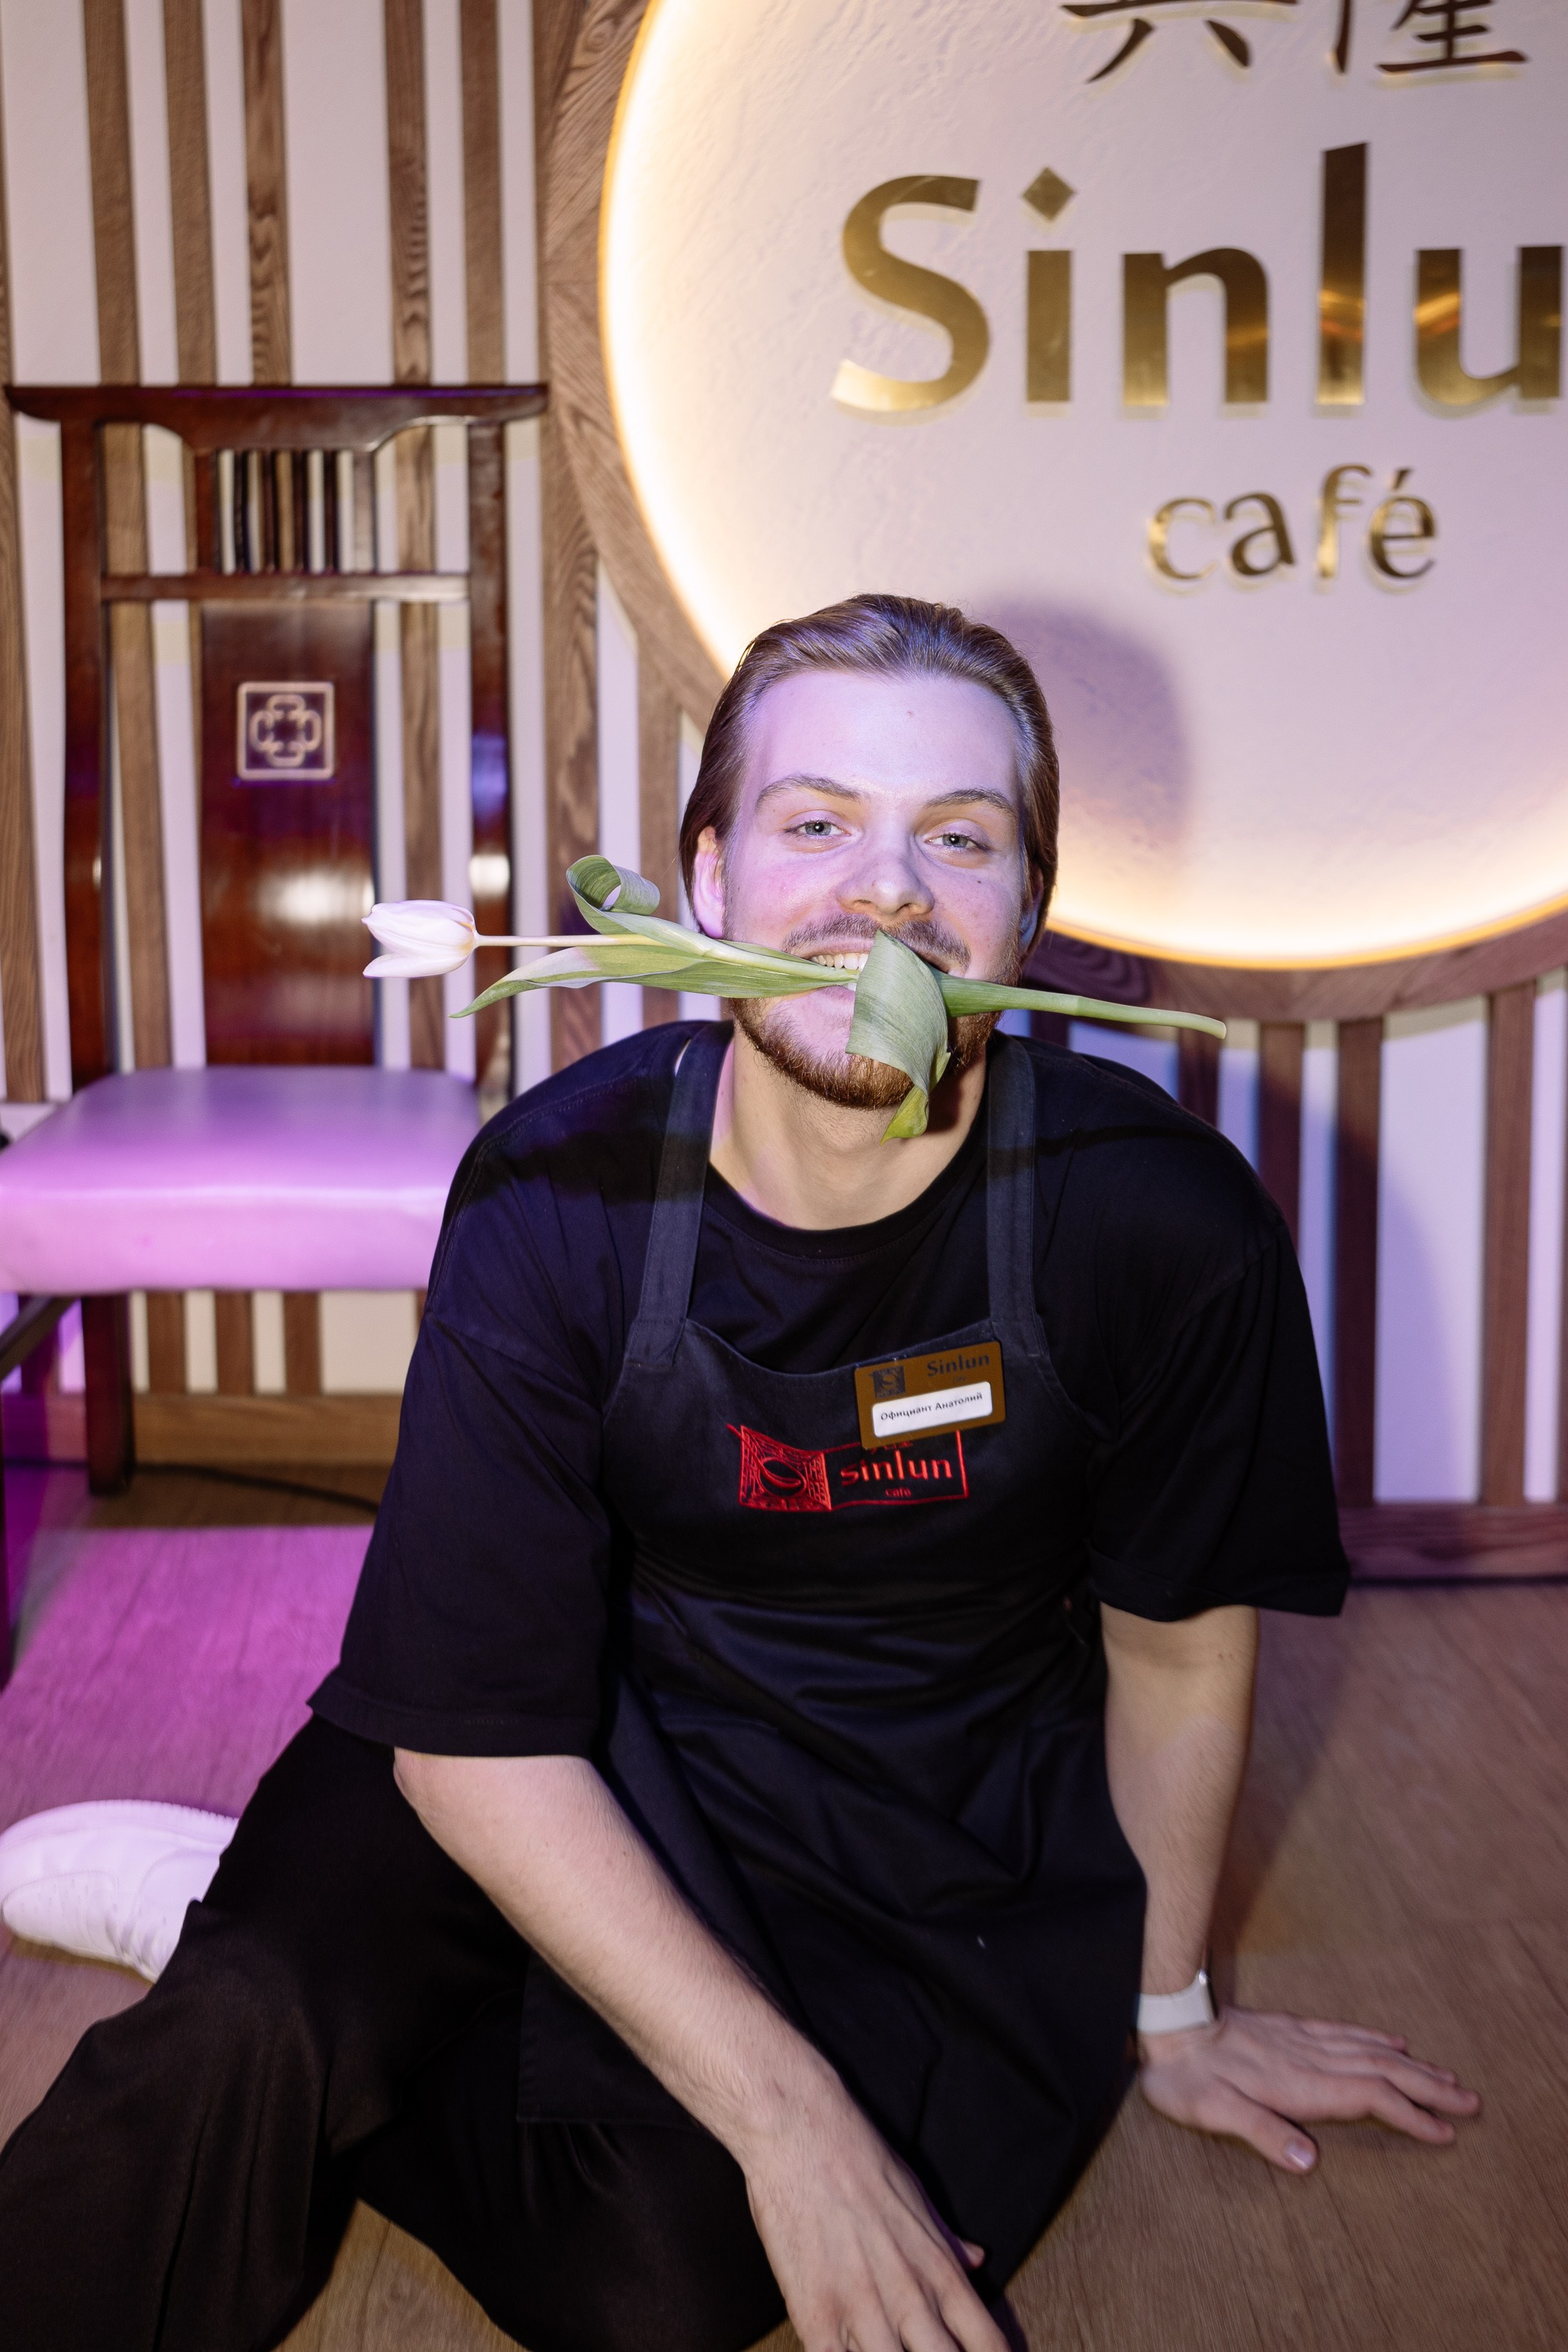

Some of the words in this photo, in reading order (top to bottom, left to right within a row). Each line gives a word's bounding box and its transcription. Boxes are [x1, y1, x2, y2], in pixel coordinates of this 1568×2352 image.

[1147, 463, 1437, 579] café
[927, 1353, 990, 1377] Sinlun
[881, 1405, 932, 1420] Официант
[935, 1392, 983, 1410] Анатолий
[840, 1450, 953, 1486] sinlun
